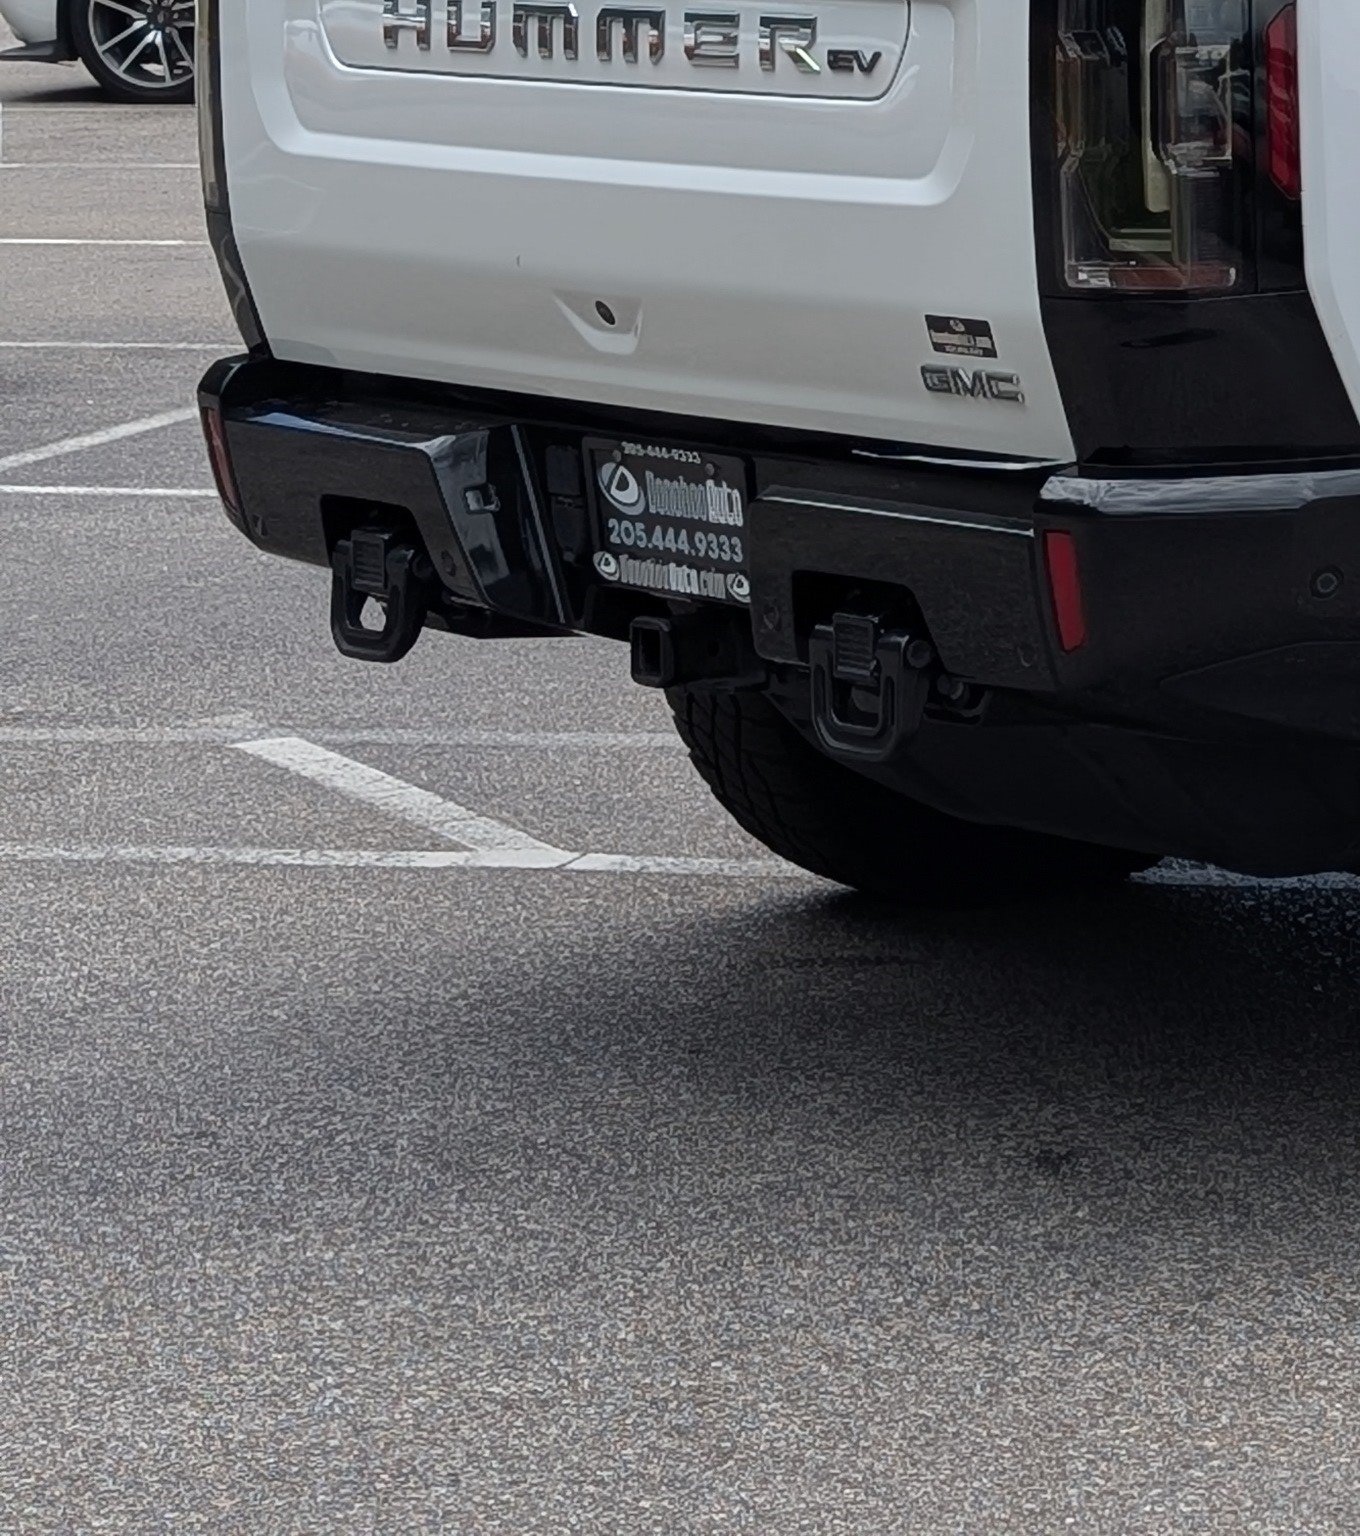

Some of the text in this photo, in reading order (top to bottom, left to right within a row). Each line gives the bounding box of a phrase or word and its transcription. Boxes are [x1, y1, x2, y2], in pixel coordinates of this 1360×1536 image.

[827, 49, 883, 75] EV
[920, 364, 1026, 404] GMC
[608, 518, 744, 563] 205.444.9333
